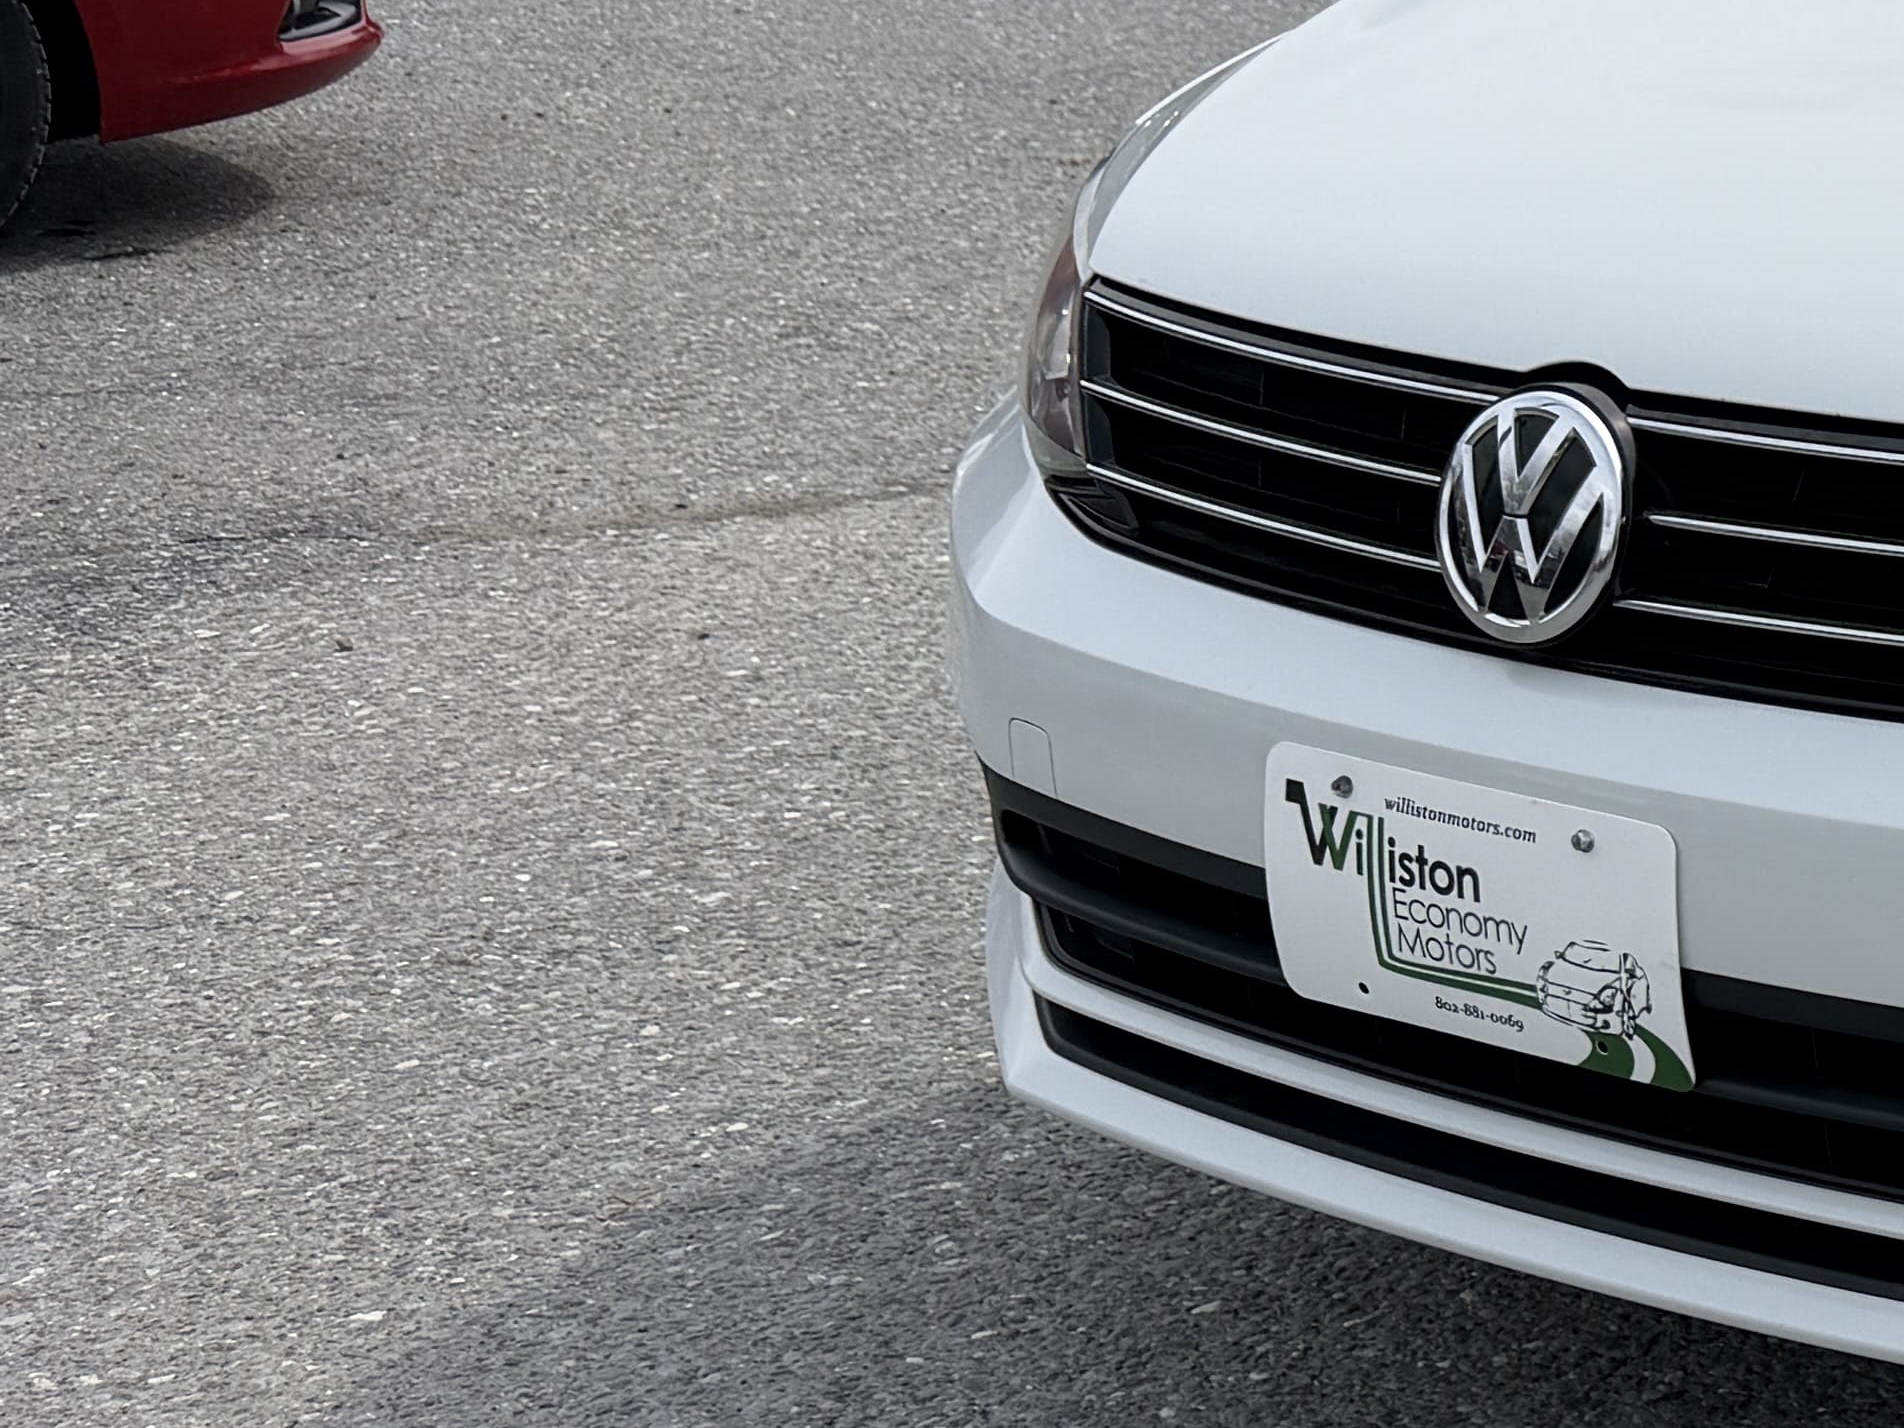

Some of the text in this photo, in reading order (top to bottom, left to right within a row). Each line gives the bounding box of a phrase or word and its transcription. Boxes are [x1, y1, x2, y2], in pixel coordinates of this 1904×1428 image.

[1285, 778, 1481, 903] Williston
[1384, 796, 1537, 844] willistonmotors.com
[1392, 887, 1527, 955] Economy
[1398, 922, 1497, 974] Motors
[1435, 996, 1524, 1032] 802-881-0069
